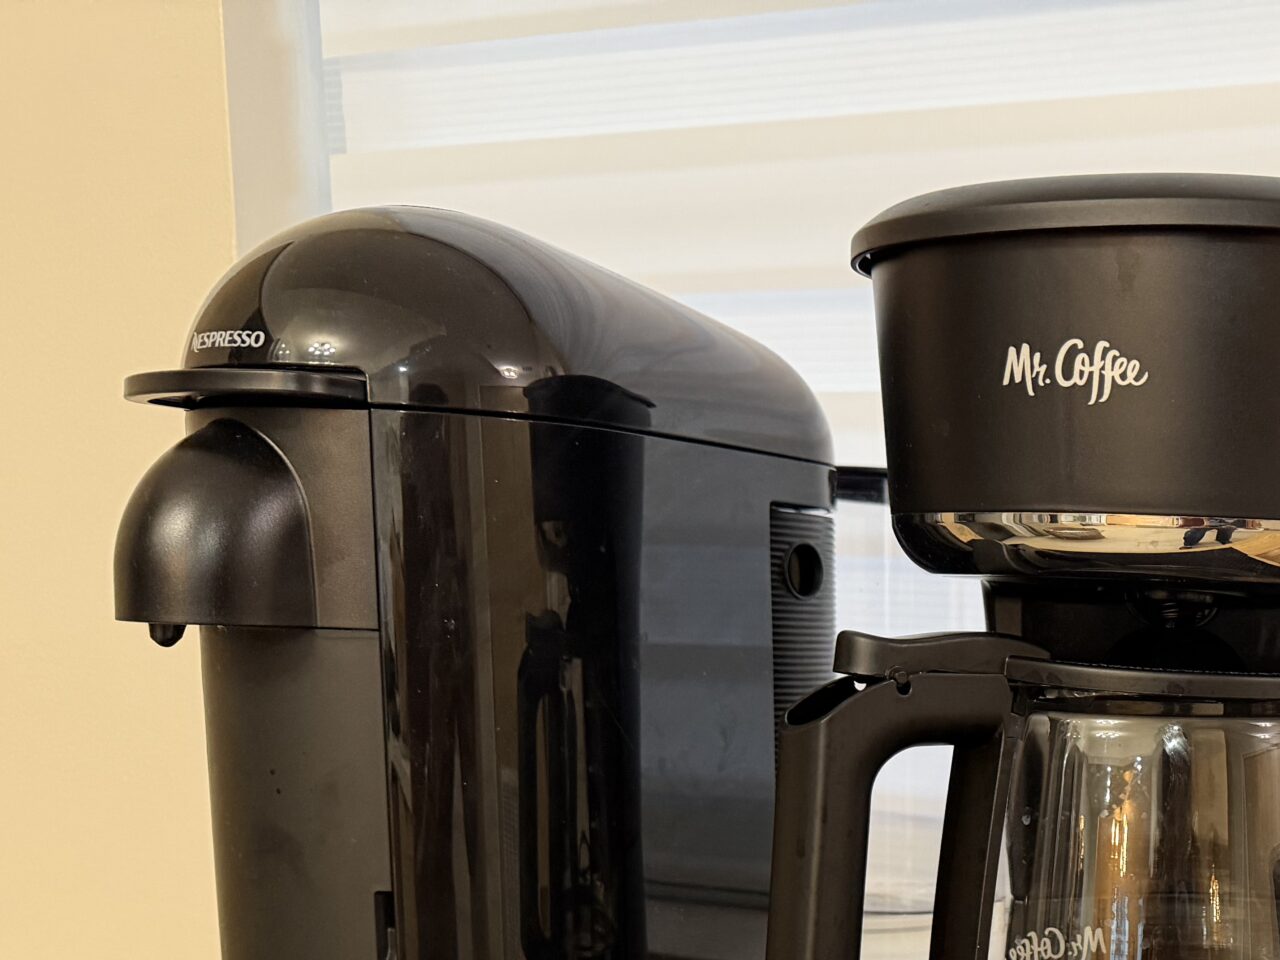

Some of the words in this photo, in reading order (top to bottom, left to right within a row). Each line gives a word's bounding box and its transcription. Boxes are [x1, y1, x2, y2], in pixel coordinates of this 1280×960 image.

[190, 329, 266, 352] NESPRESSO
[1002, 342, 1051, 397] Mr.
[1054, 338, 1149, 406] Coffee
